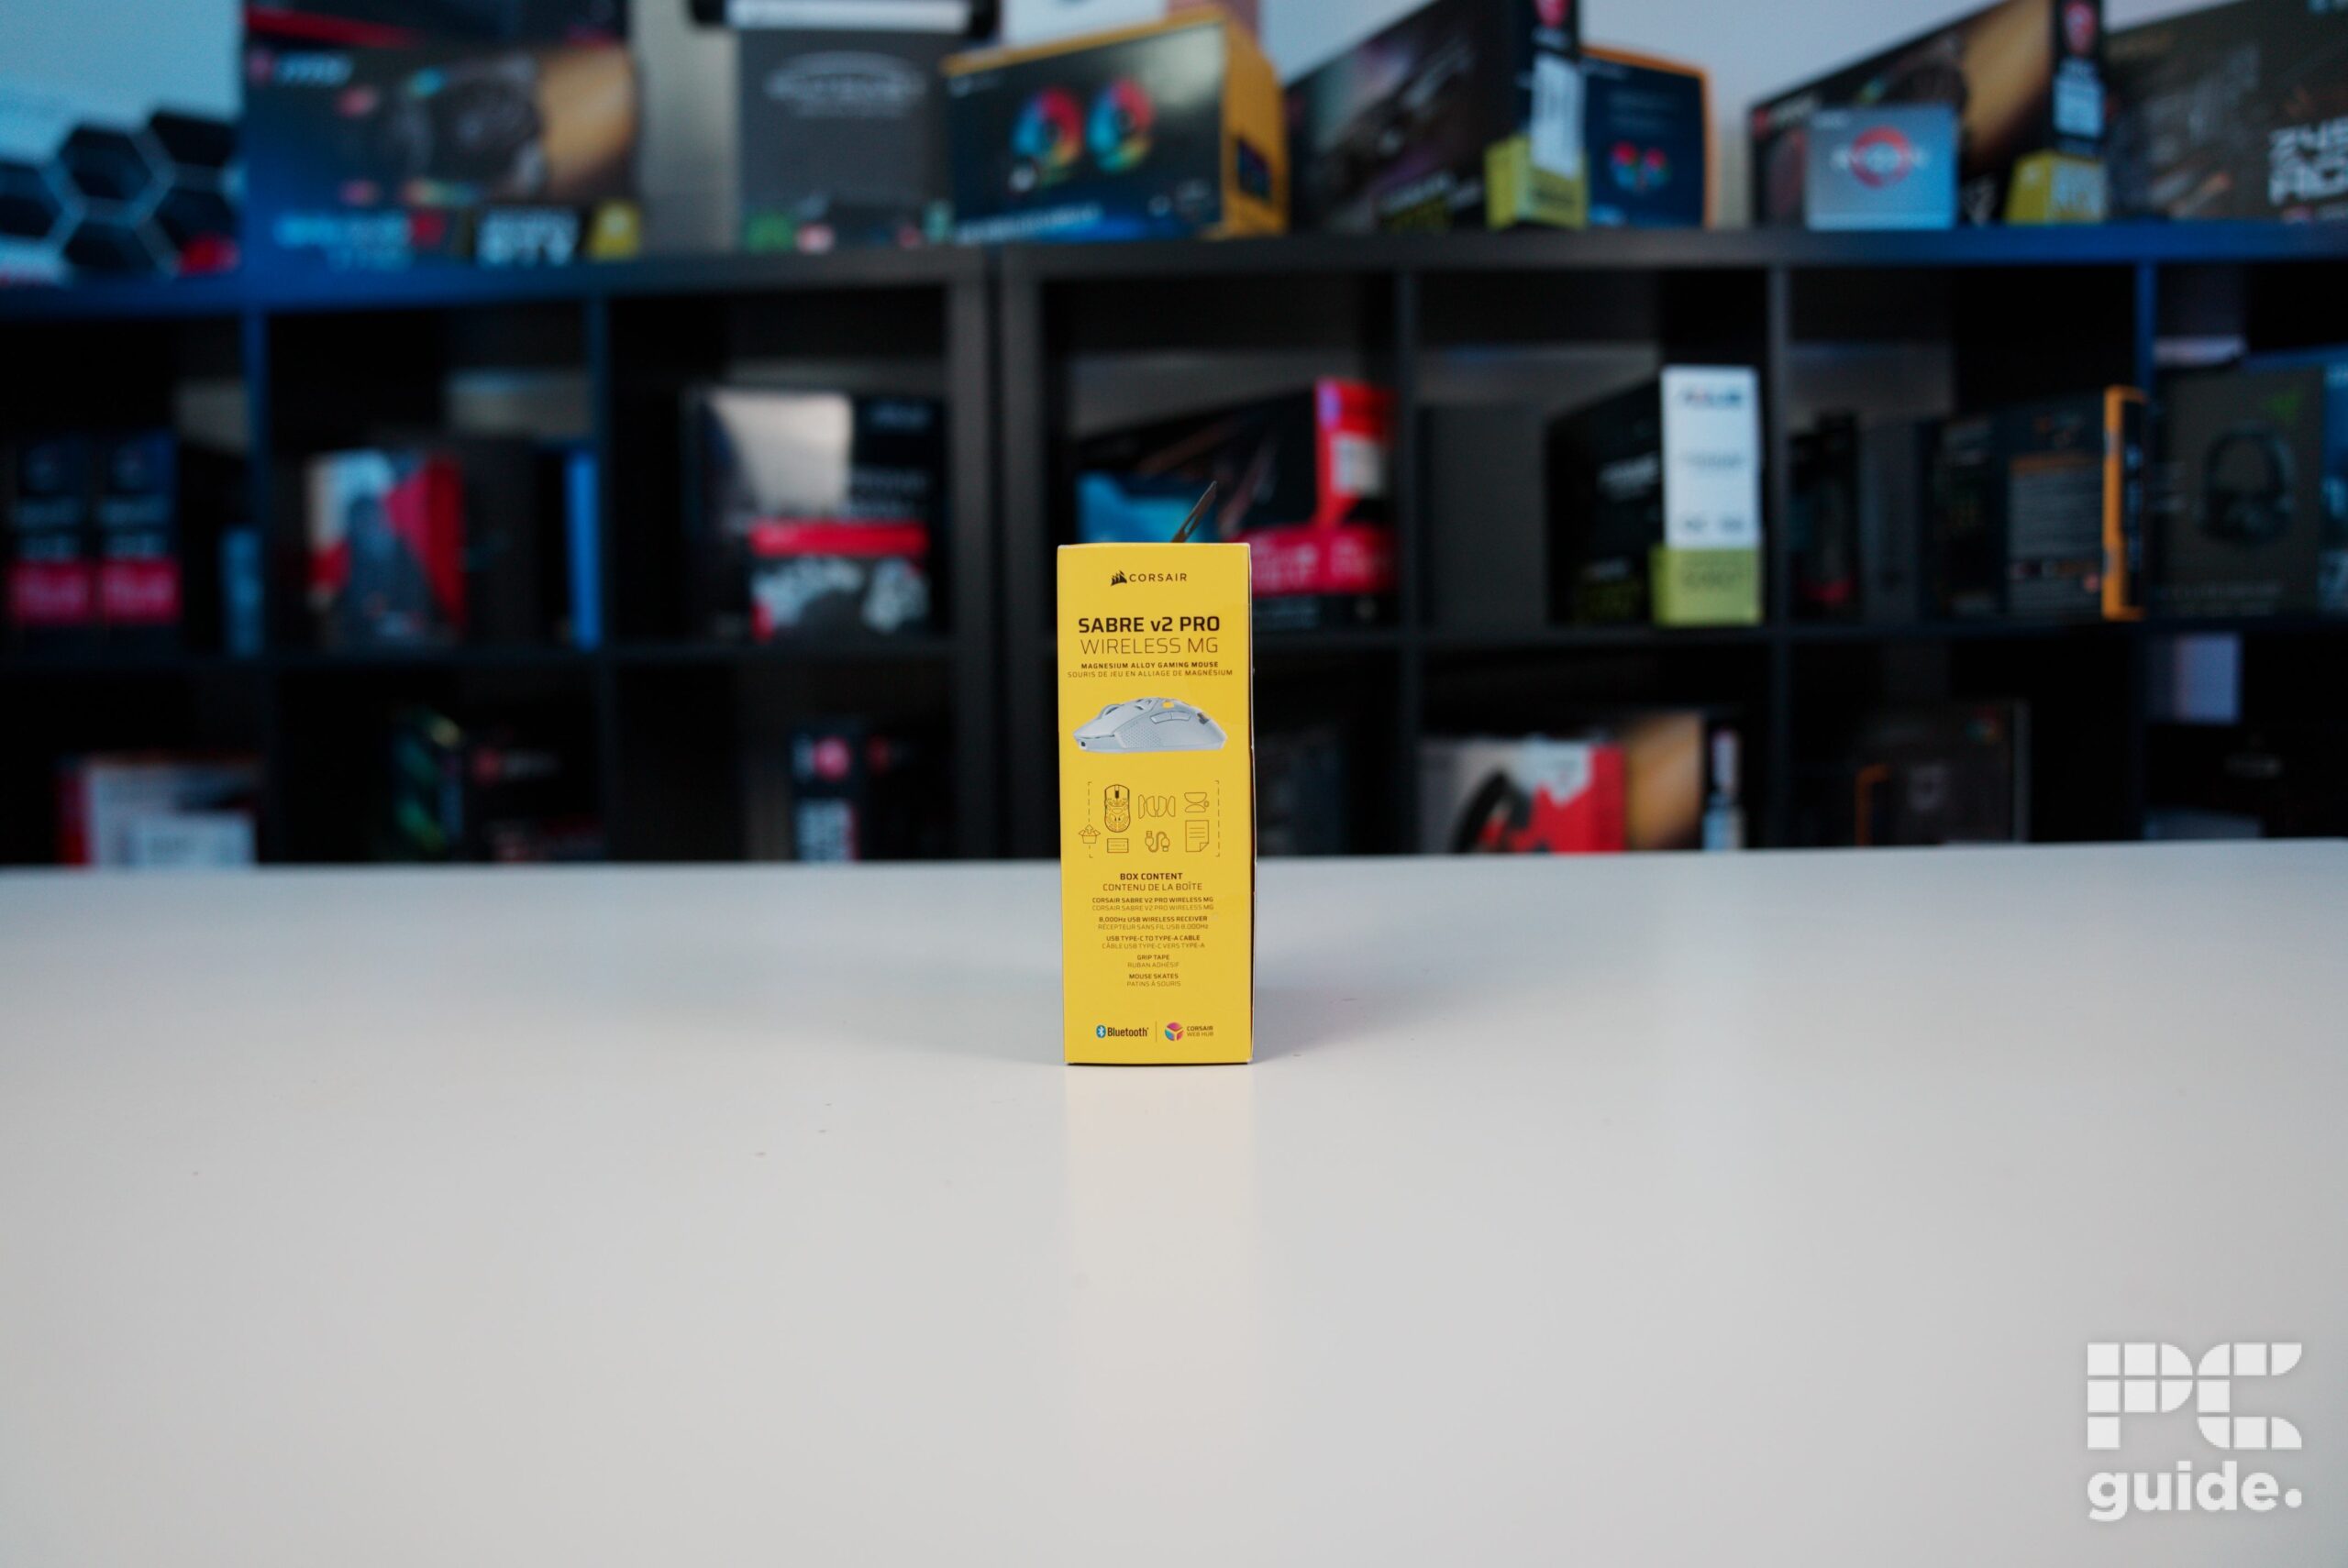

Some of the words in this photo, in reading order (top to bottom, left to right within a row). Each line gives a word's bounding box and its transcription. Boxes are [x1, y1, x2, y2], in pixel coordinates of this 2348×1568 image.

[1129, 573, 1188, 582] CORSAIR
[1078, 617, 1145, 634] SABRE
[1150, 616, 1173, 632] v2
[1180, 615, 1220, 632] PRO
[1080, 637, 1181, 655] WIRELESS
[1188, 636, 1218, 654] MG
[1184, 668, 1233, 677] MAGNÉSIUM
[1141, 872, 1183, 880] CONTENT
[1102, 883, 1146, 891] CONTENU
[1147, 883, 1160, 891] DE
[1161, 883, 1174, 891] LA
[1175, 881, 1202, 891] BOÎTE
[1107, 1027, 1147, 1037] Bluetooth
